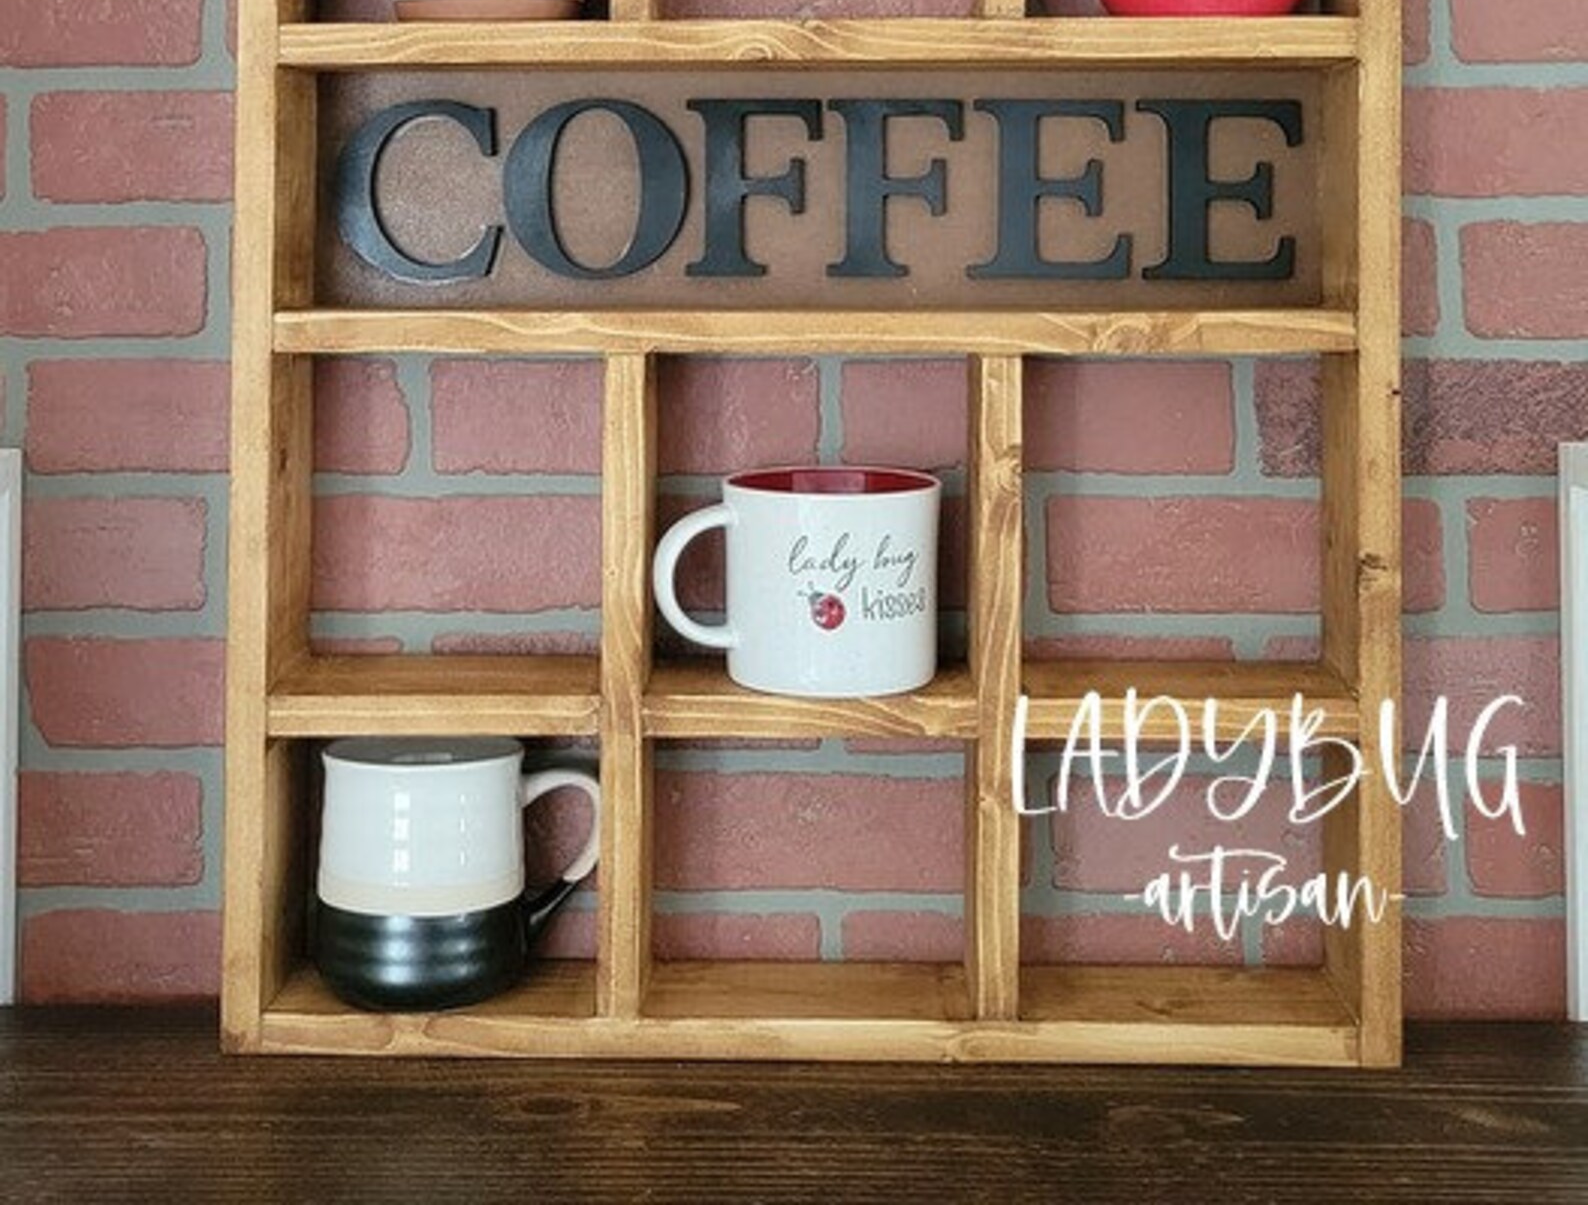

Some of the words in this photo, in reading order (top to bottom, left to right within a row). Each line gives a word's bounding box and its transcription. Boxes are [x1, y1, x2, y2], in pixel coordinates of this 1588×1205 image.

[335, 97, 1304, 284] COFFEE
[788, 532, 866, 593] lady
[873, 534, 918, 588] bug
[861, 587, 926, 621] kisses
